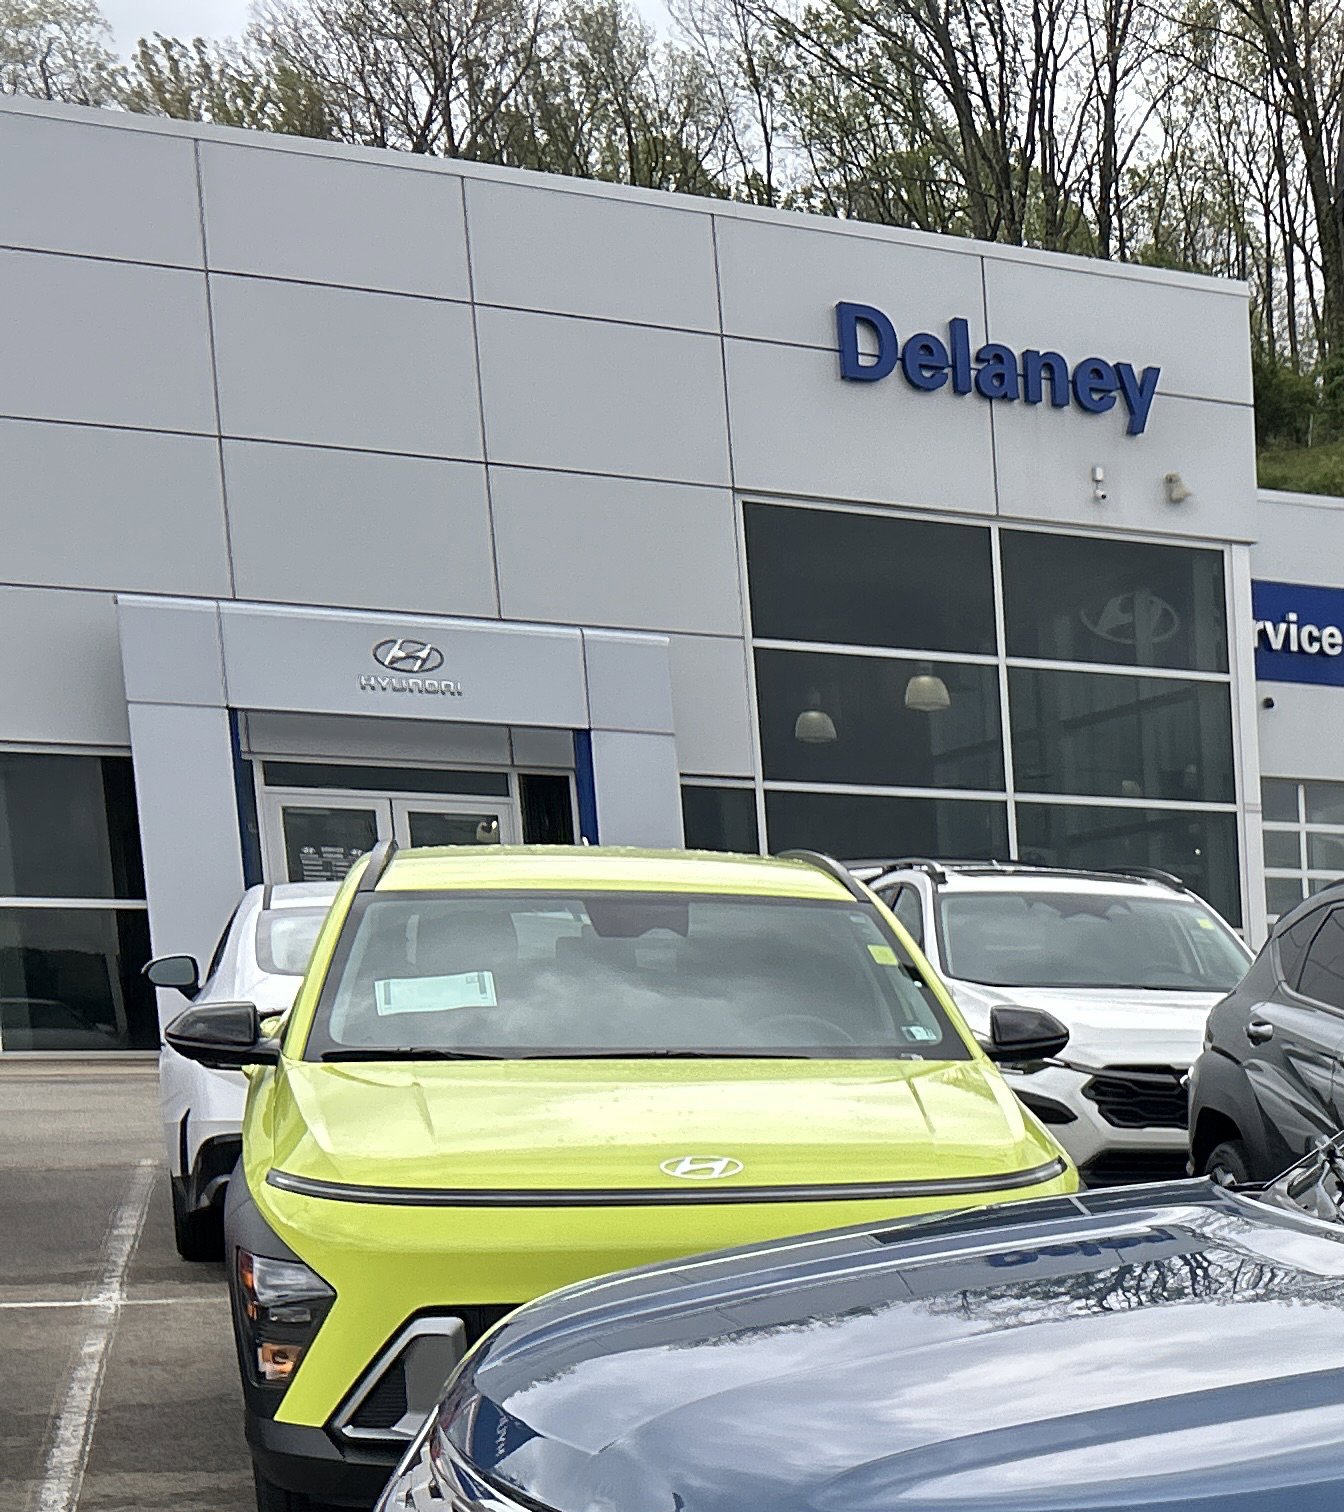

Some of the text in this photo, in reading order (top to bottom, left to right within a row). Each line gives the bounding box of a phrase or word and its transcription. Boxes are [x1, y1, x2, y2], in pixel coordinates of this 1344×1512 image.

[836, 301, 1161, 436] Delaney
[1252, 612, 1343, 656] rvice
[360, 675, 463, 697] HYUNDAI
